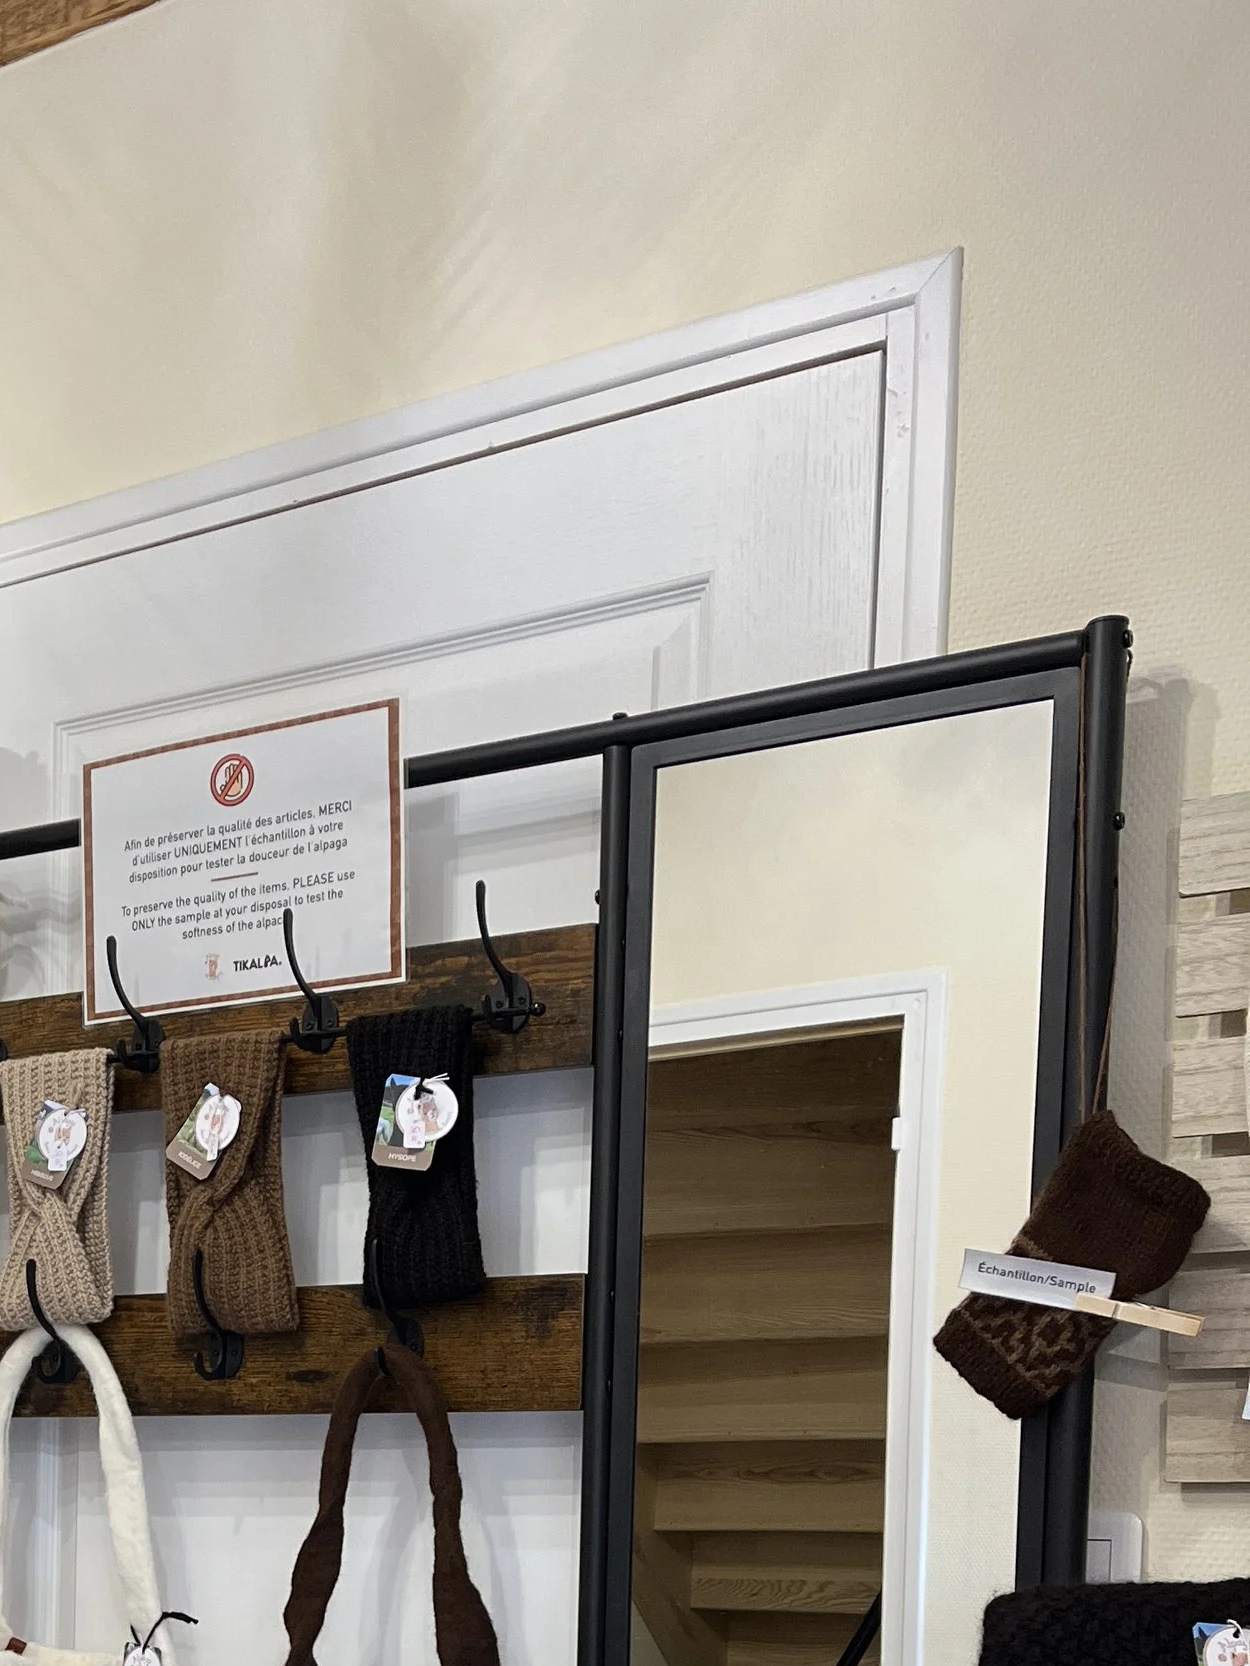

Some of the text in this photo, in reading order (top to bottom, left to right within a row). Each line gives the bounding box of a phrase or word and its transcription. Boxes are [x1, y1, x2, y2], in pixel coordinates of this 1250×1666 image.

[125, 839, 142, 851] Afin
[145, 837, 155, 847] de
[158, 829, 204, 848] préserver
[207, 825, 215, 836] la
[219, 818, 252, 836] qualité
[255, 816, 272, 828] des
[319, 800, 352, 816] MERCI
[133, 822, 343, 866] d'utiliser UNIQUEMENT l'échantillon à votre
[129, 839, 347, 884] disposition pour tester la douceur de l'alpaga
[121, 906, 131, 917] To
[134, 901, 173, 918] preserve
[176, 896, 191, 908] the
[194, 891, 226, 907] quality
[229, 887, 238, 899] of
[241, 886, 256, 898] the
[293, 872, 334, 889] PLEASE
[337, 871, 355, 881] use
[132, 889, 343, 931] ONLY the sample at your disposal to test the
[183, 917, 282, 939] softness of the alpac
[388, 1152, 417, 1162] HYSOPE
[978, 1261, 1096, 1294] Échantillon/Sample
